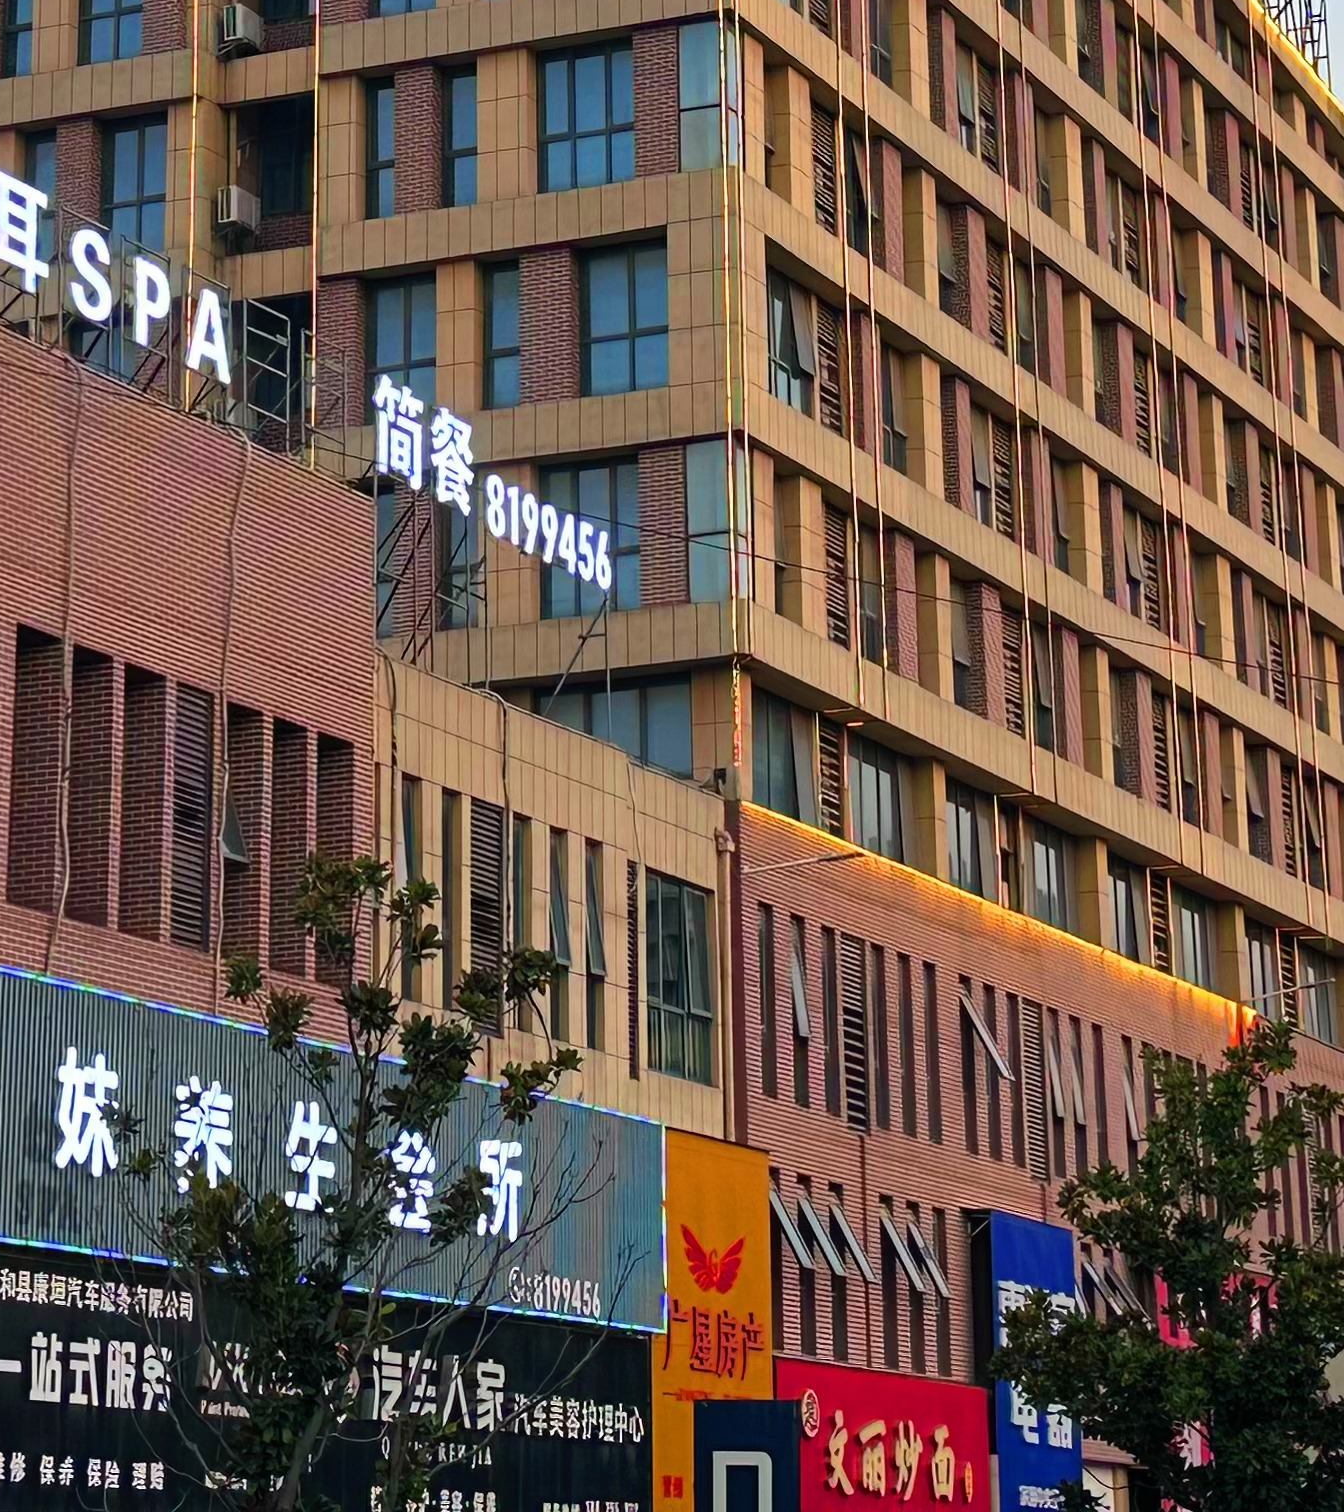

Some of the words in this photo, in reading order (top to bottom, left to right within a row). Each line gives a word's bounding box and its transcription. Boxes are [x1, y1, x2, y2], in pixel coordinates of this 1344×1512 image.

[373, 374, 475, 517] 简餐
[485, 473, 612, 590] 8199456
[514, 1393, 645, 1444] 汽车美容护理中心
